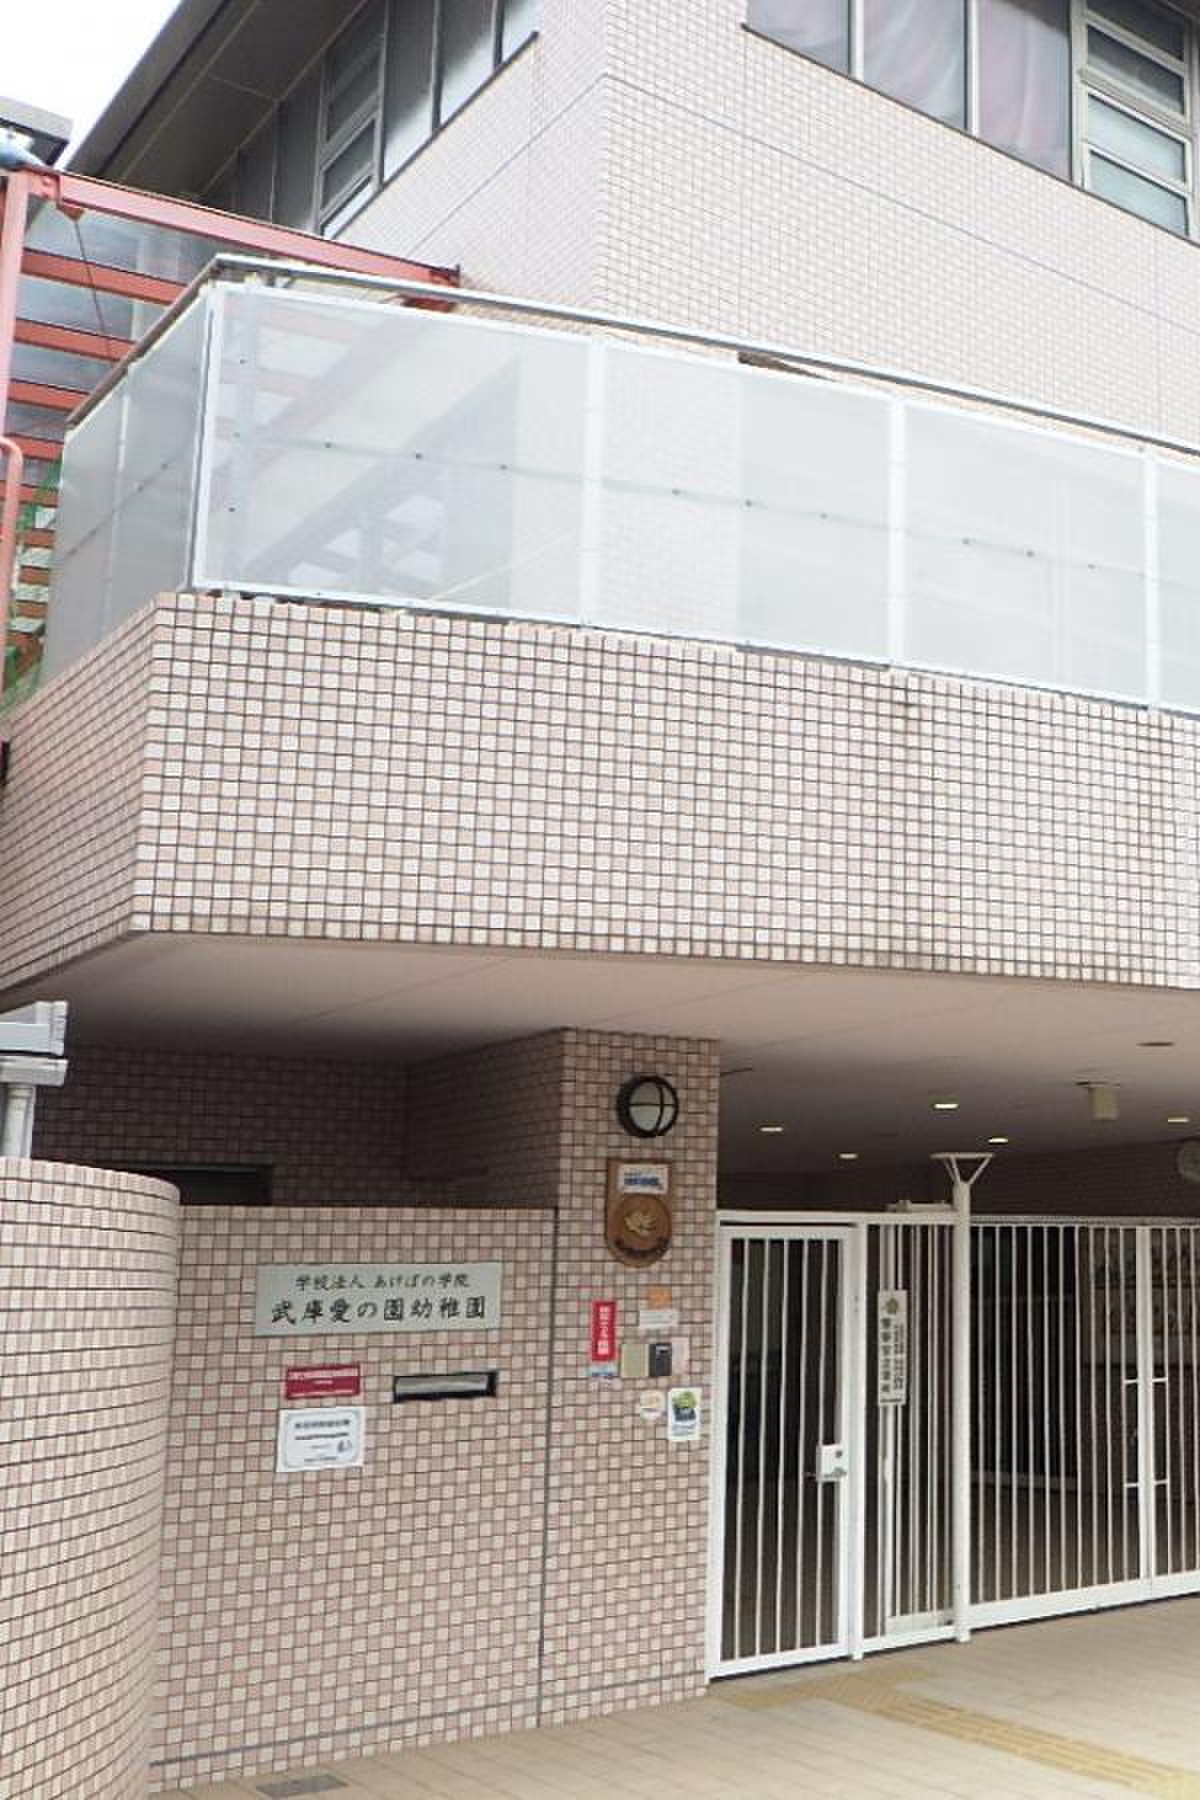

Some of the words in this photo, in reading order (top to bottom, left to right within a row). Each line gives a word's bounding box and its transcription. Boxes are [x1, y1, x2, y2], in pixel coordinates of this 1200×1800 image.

[271, 1296, 485, 1325] 武庫愛の園幼稚園
